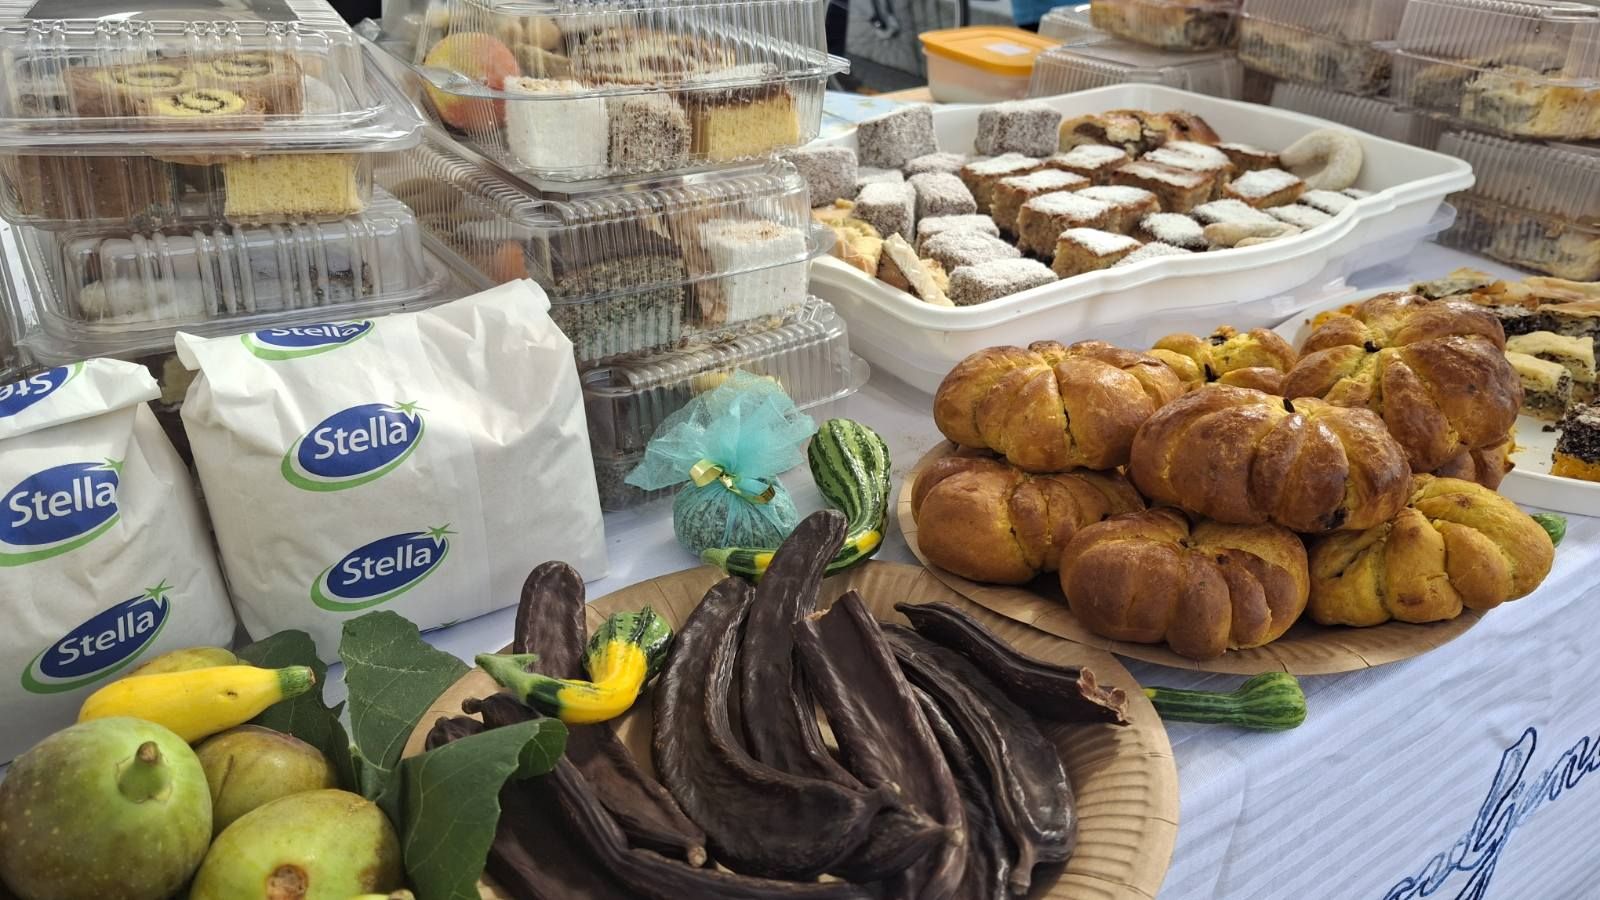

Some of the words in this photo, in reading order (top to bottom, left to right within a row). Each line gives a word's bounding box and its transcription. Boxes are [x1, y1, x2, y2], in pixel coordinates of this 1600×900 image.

[271, 325, 360, 338] Stella
[313, 415, 407, 460] Stella
[9, 475, 117, 528] Stella
[342, 543, 432, 586] Stella
[57, 605, 155, 666] Stella
